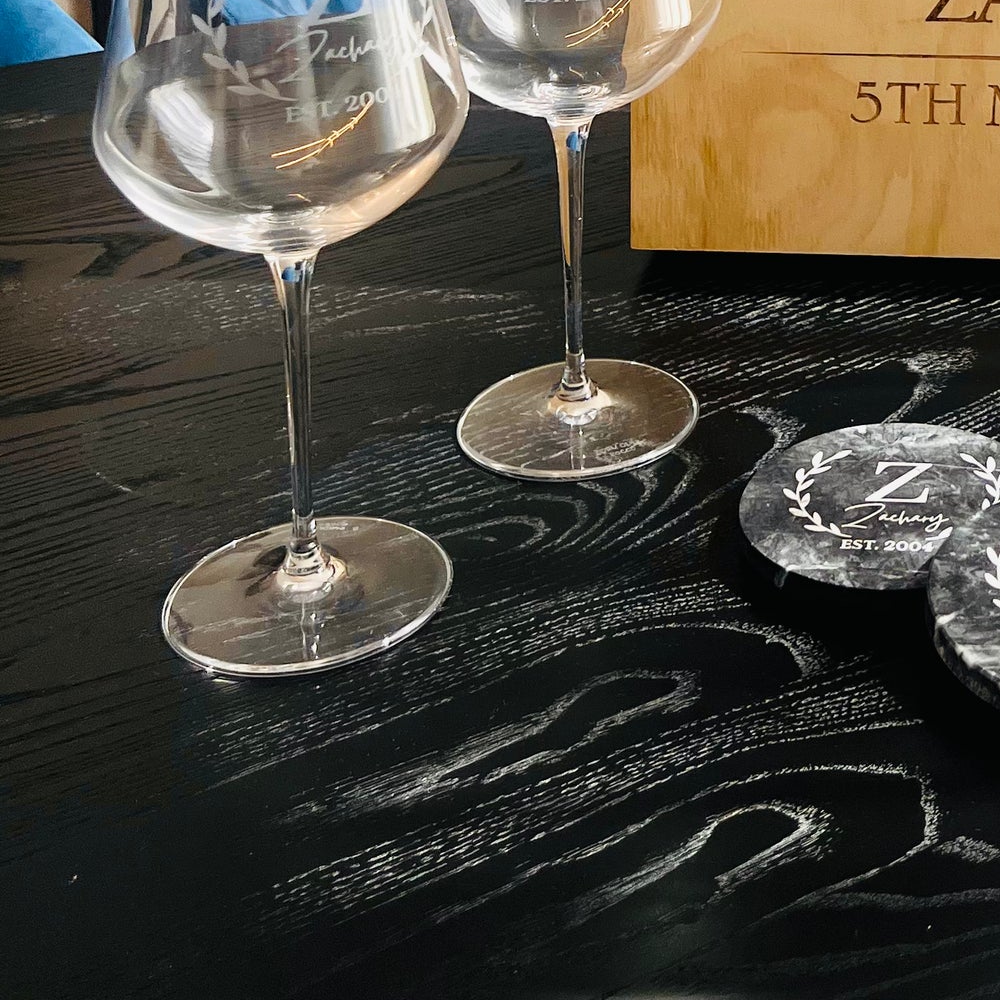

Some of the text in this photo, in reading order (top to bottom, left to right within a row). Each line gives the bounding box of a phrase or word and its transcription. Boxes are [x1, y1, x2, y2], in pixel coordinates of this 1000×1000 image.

[274, 29, 402, 84] Zacha
[285, 85, 396, 124] ET. 200
[850, 80, 964, 128] 5TH
[864, 461, 934, 504] Z
[840, 502, 950, 533] Zachary
[839, 539, 935, 553] EST. 2004
